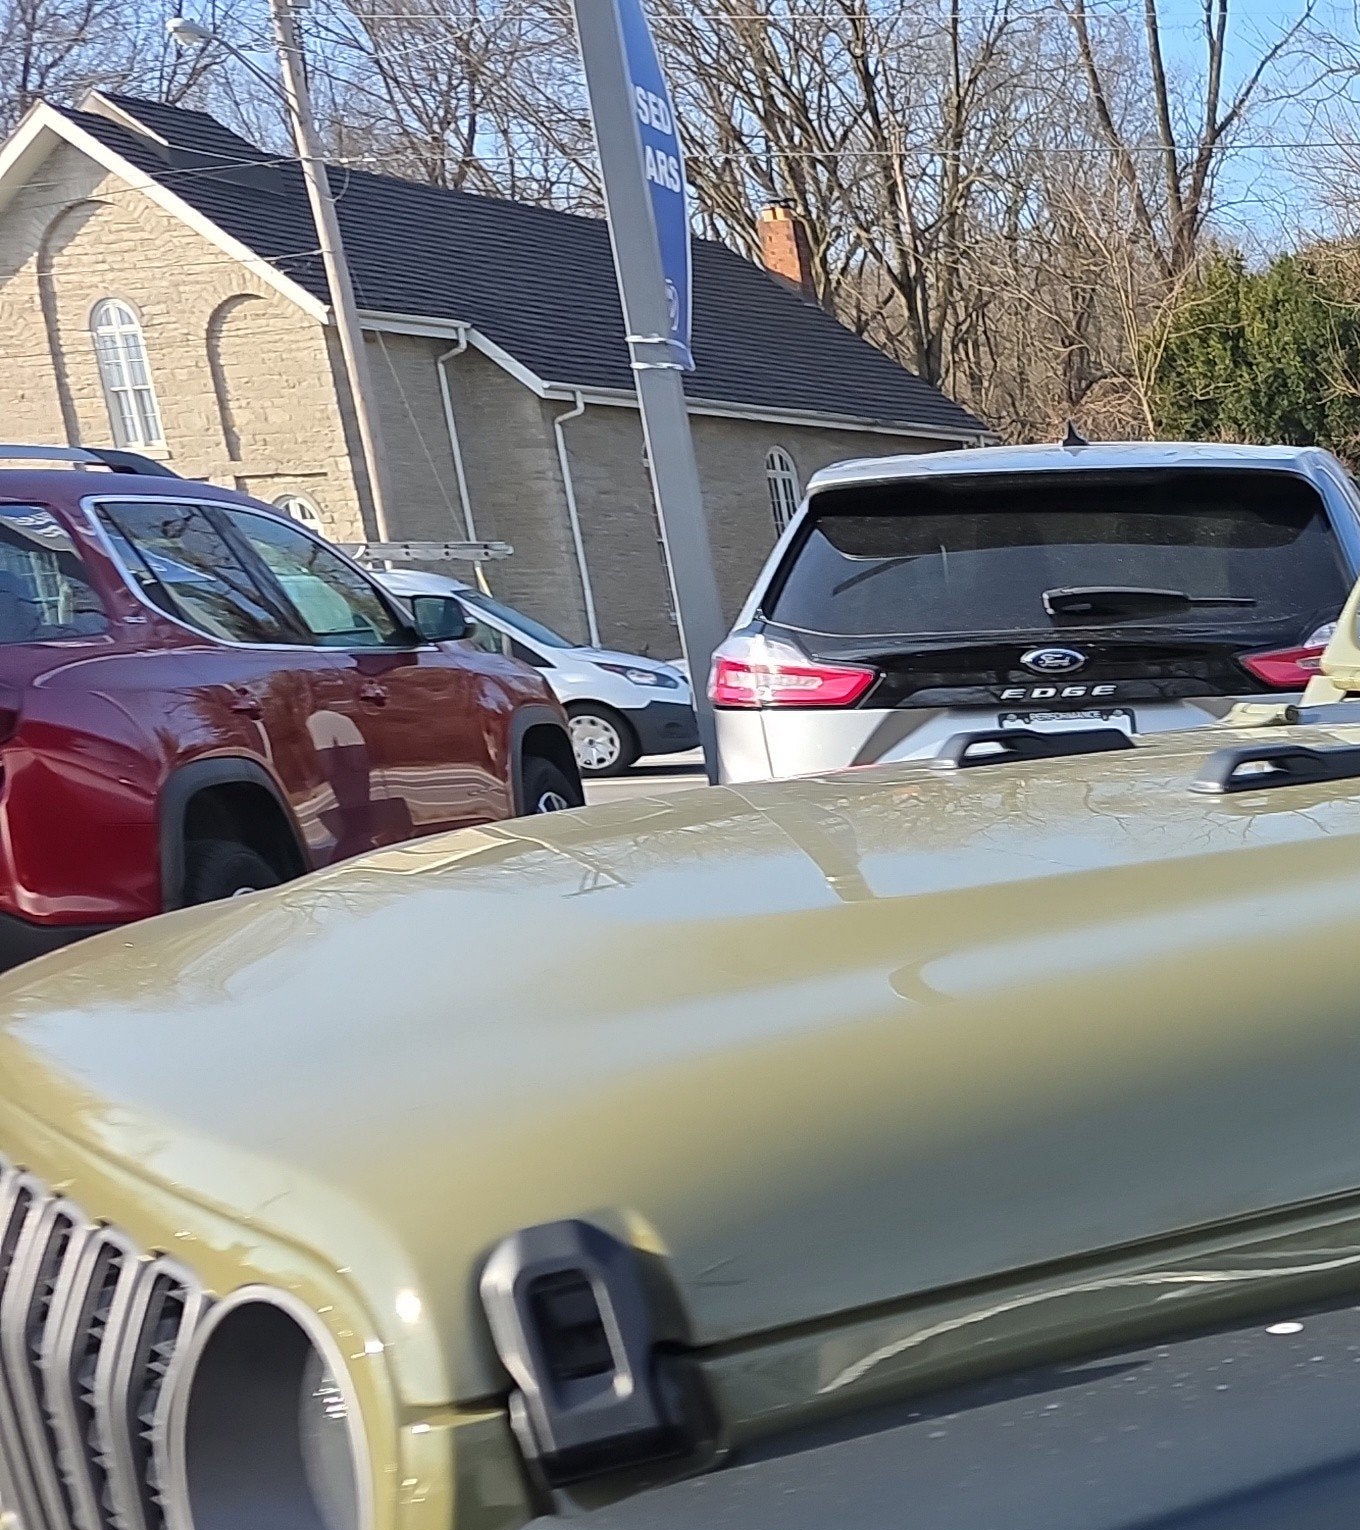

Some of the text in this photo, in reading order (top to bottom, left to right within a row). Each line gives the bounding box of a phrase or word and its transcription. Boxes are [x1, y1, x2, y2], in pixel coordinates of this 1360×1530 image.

[635, 85, 673, 136] SED
[645, 145, 682, 194] ARS
[1000, 684, 1117, 700] EDGE
